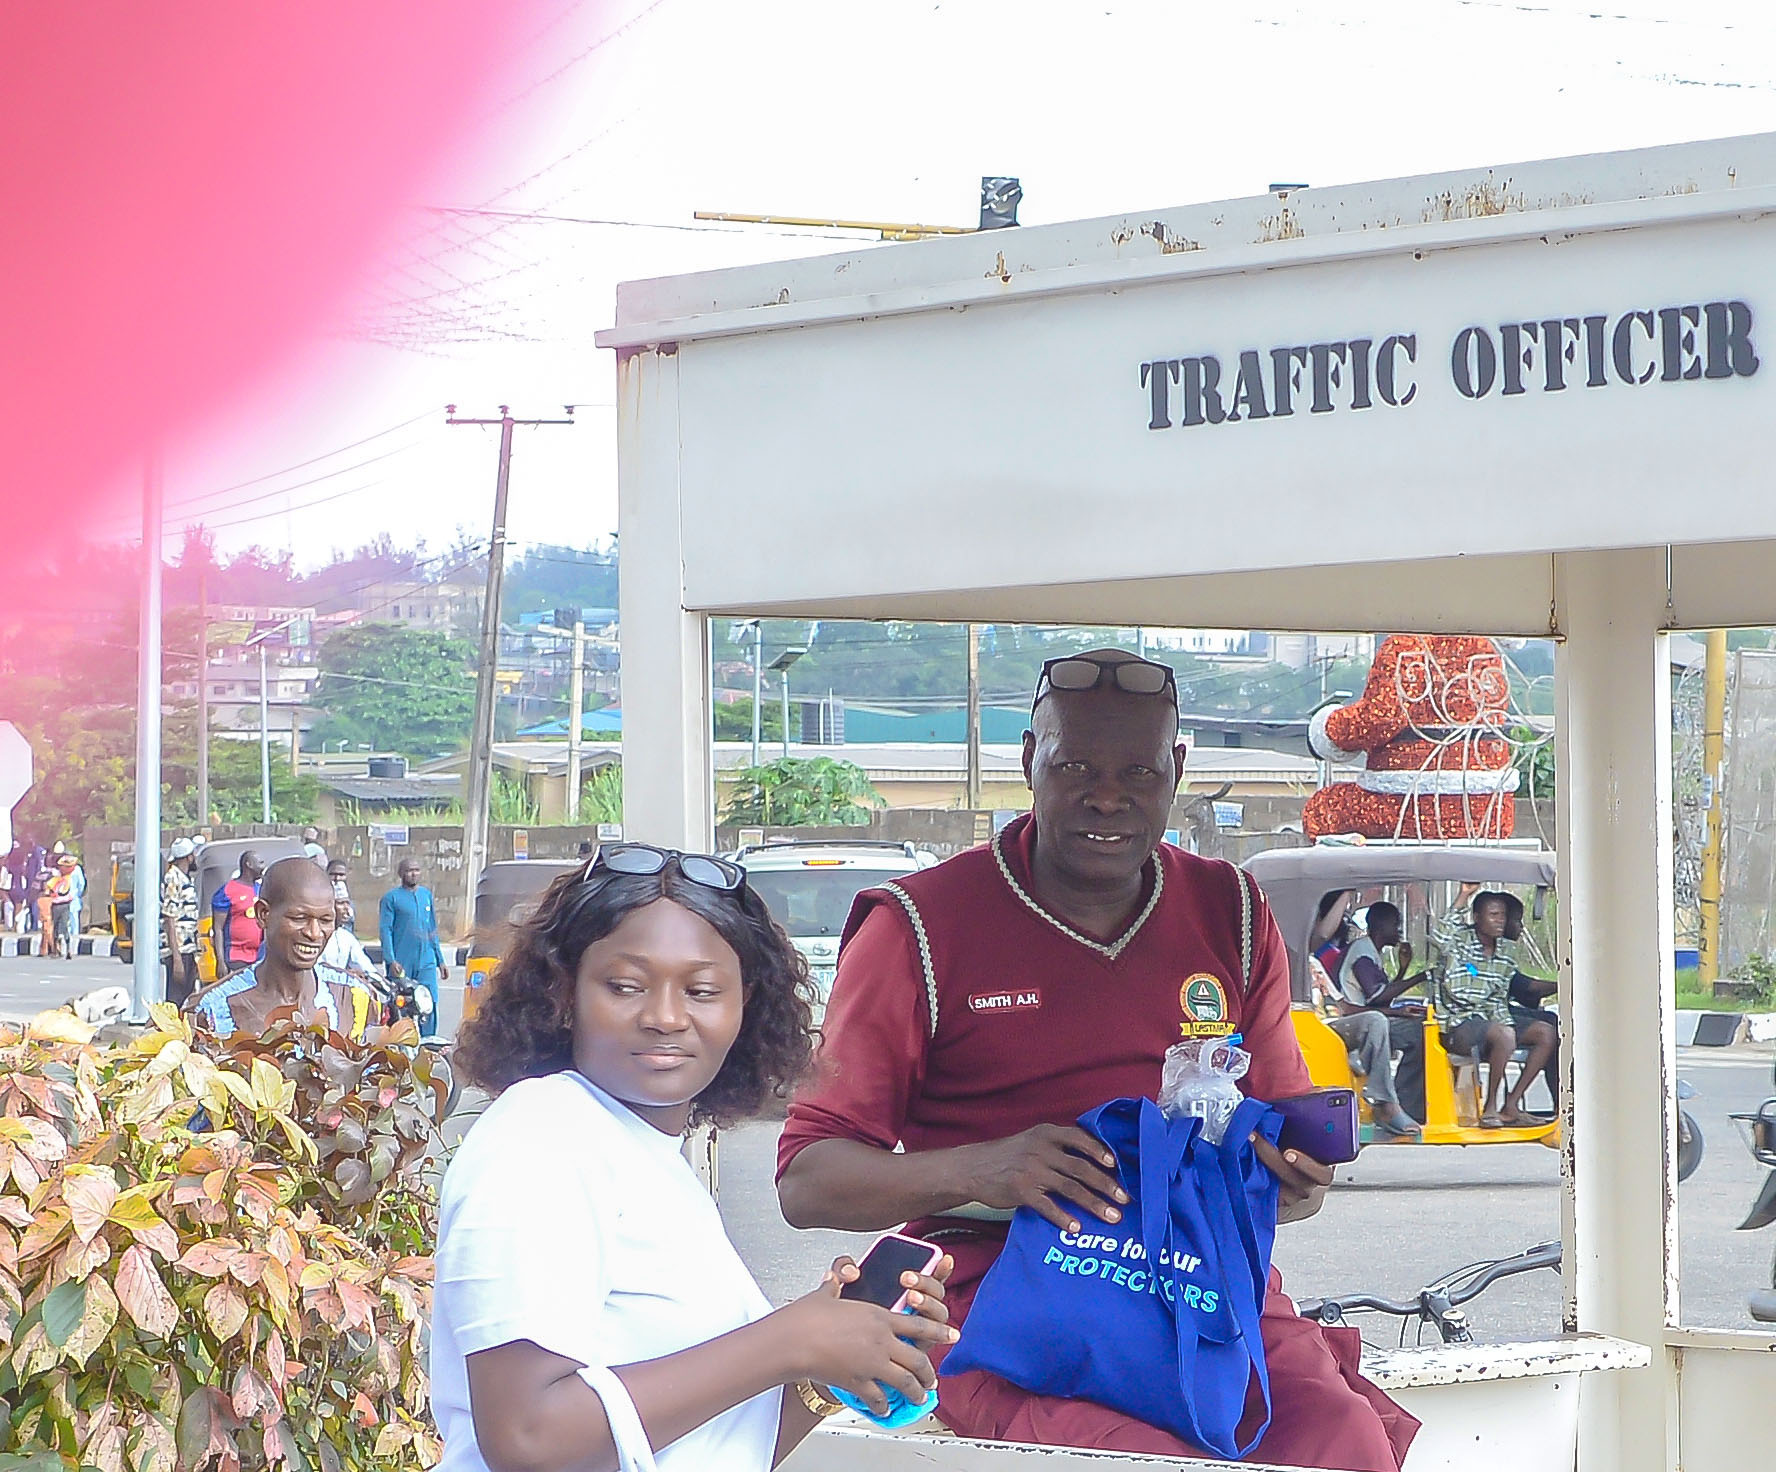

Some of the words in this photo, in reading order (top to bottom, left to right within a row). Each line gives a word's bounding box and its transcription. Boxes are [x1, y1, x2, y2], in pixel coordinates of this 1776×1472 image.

[1140, 334, 1418, 431] TRAFFIC
[1451, 301, 1761, 399] OFFICER
[974, 995, 1012, 1009] SMITH
[1058, 1229, 1119, 1252] Care
